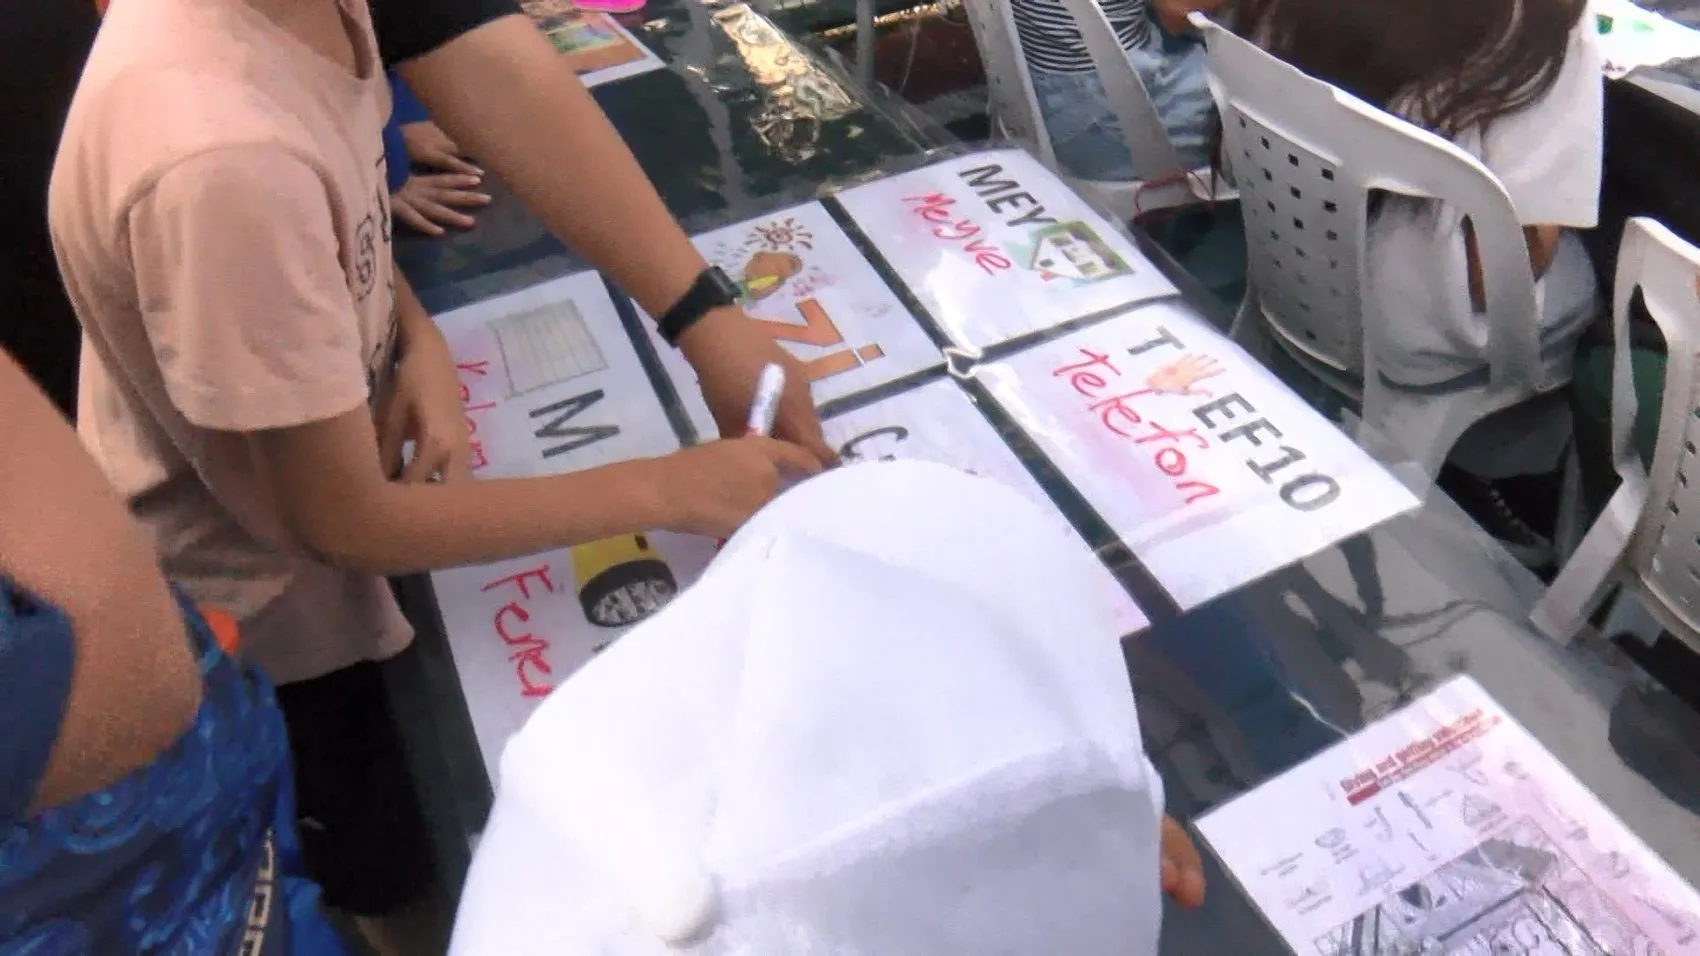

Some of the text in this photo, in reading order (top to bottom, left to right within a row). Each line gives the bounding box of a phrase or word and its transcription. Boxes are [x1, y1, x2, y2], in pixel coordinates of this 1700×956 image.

[958, 163, 1058, 227] MEY
[902, 192, 1012, 276] Meyve
[1126, 325, 1186, 357] T
[528, 388, 621, 459] M
